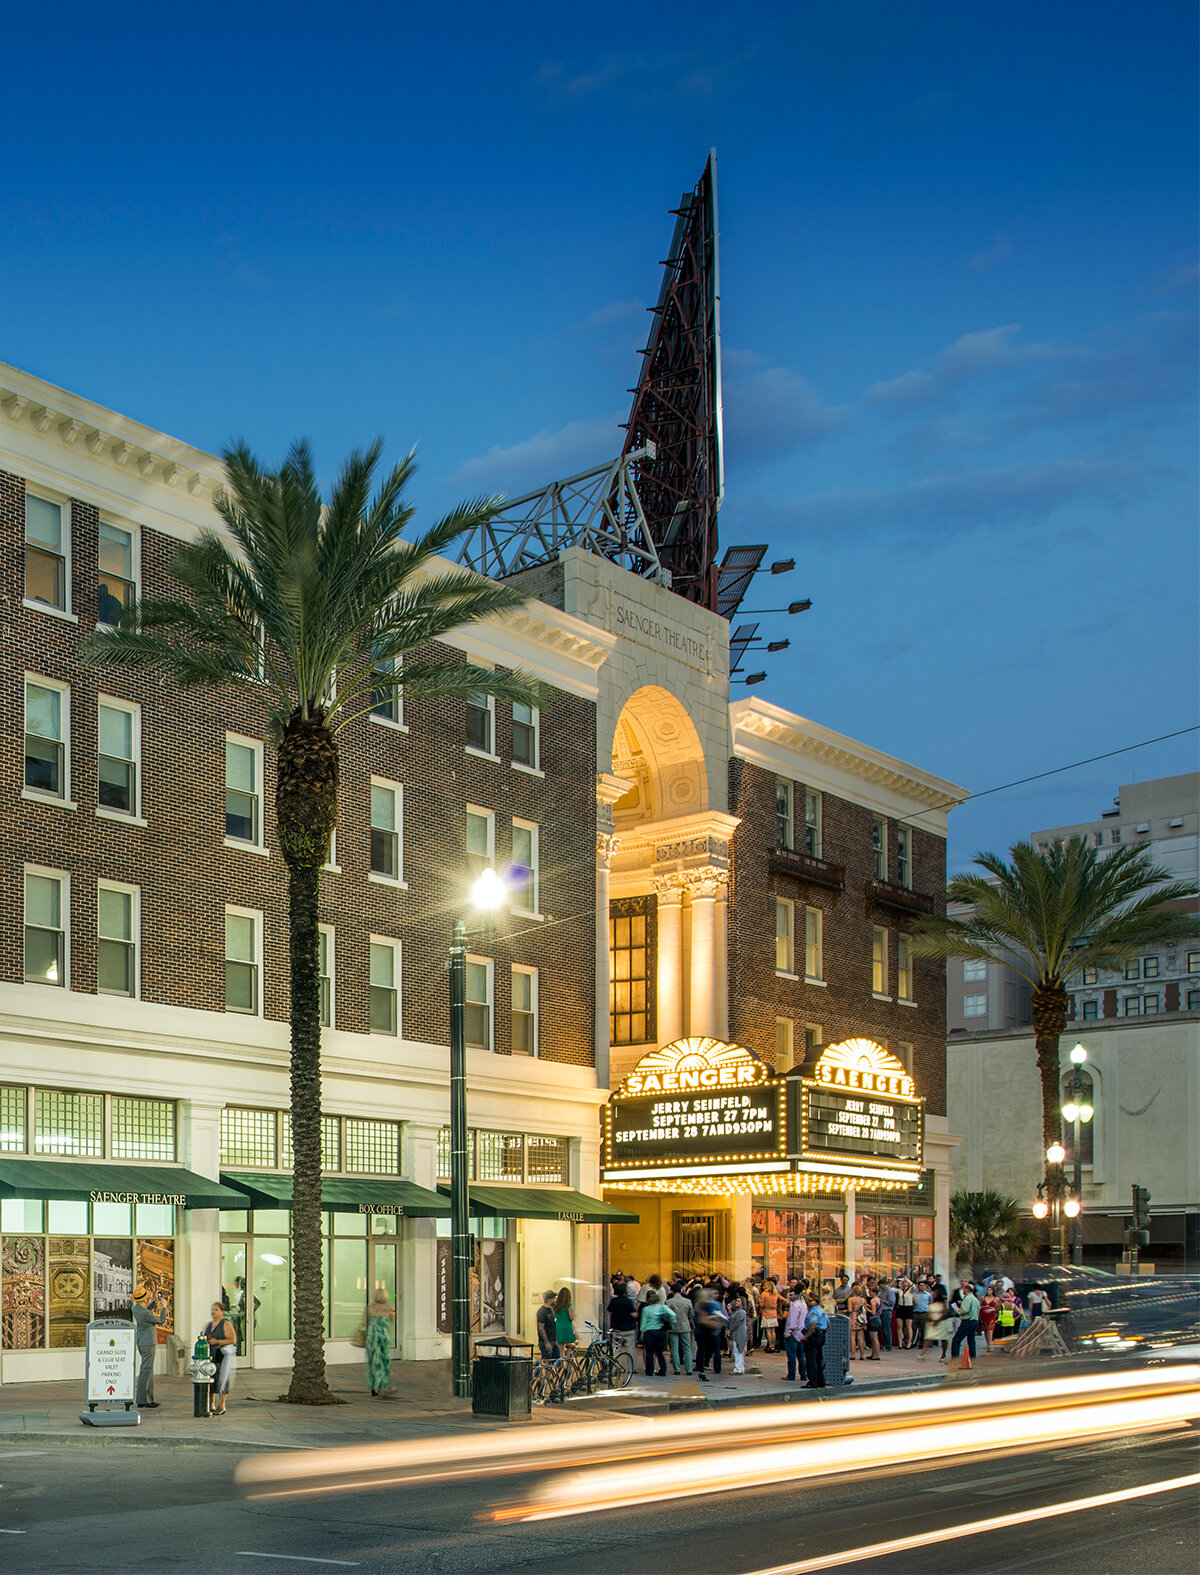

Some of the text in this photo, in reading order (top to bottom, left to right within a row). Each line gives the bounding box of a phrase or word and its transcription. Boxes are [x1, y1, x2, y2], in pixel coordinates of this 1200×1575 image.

[616, 606, 705, 661] SAENGER THEATRE
[627, 1065, 756, 1093] SAENGER
[821, 1065, 911, 1096] SAENGER
[651, 1095, 751, 1115] JERRY SEINFELD
[845, 1099, 894, 1117] JERRY SEINFELD
[652, 1107, 768, 1128] SEPTEMBER 27 7PM
[838, 1110, 871, 1126] SEPTEMBER
[615, 1127, 680, 1143] SEPTEMBER
[683, 1126, 699, 1138] 28
[827, 1122, 861, 1138] SEPTEMBER
[90, 1190, 187, 1206] SAENGER THEATRE
[358, 1203, 404, 1216] BOX OFFICE
